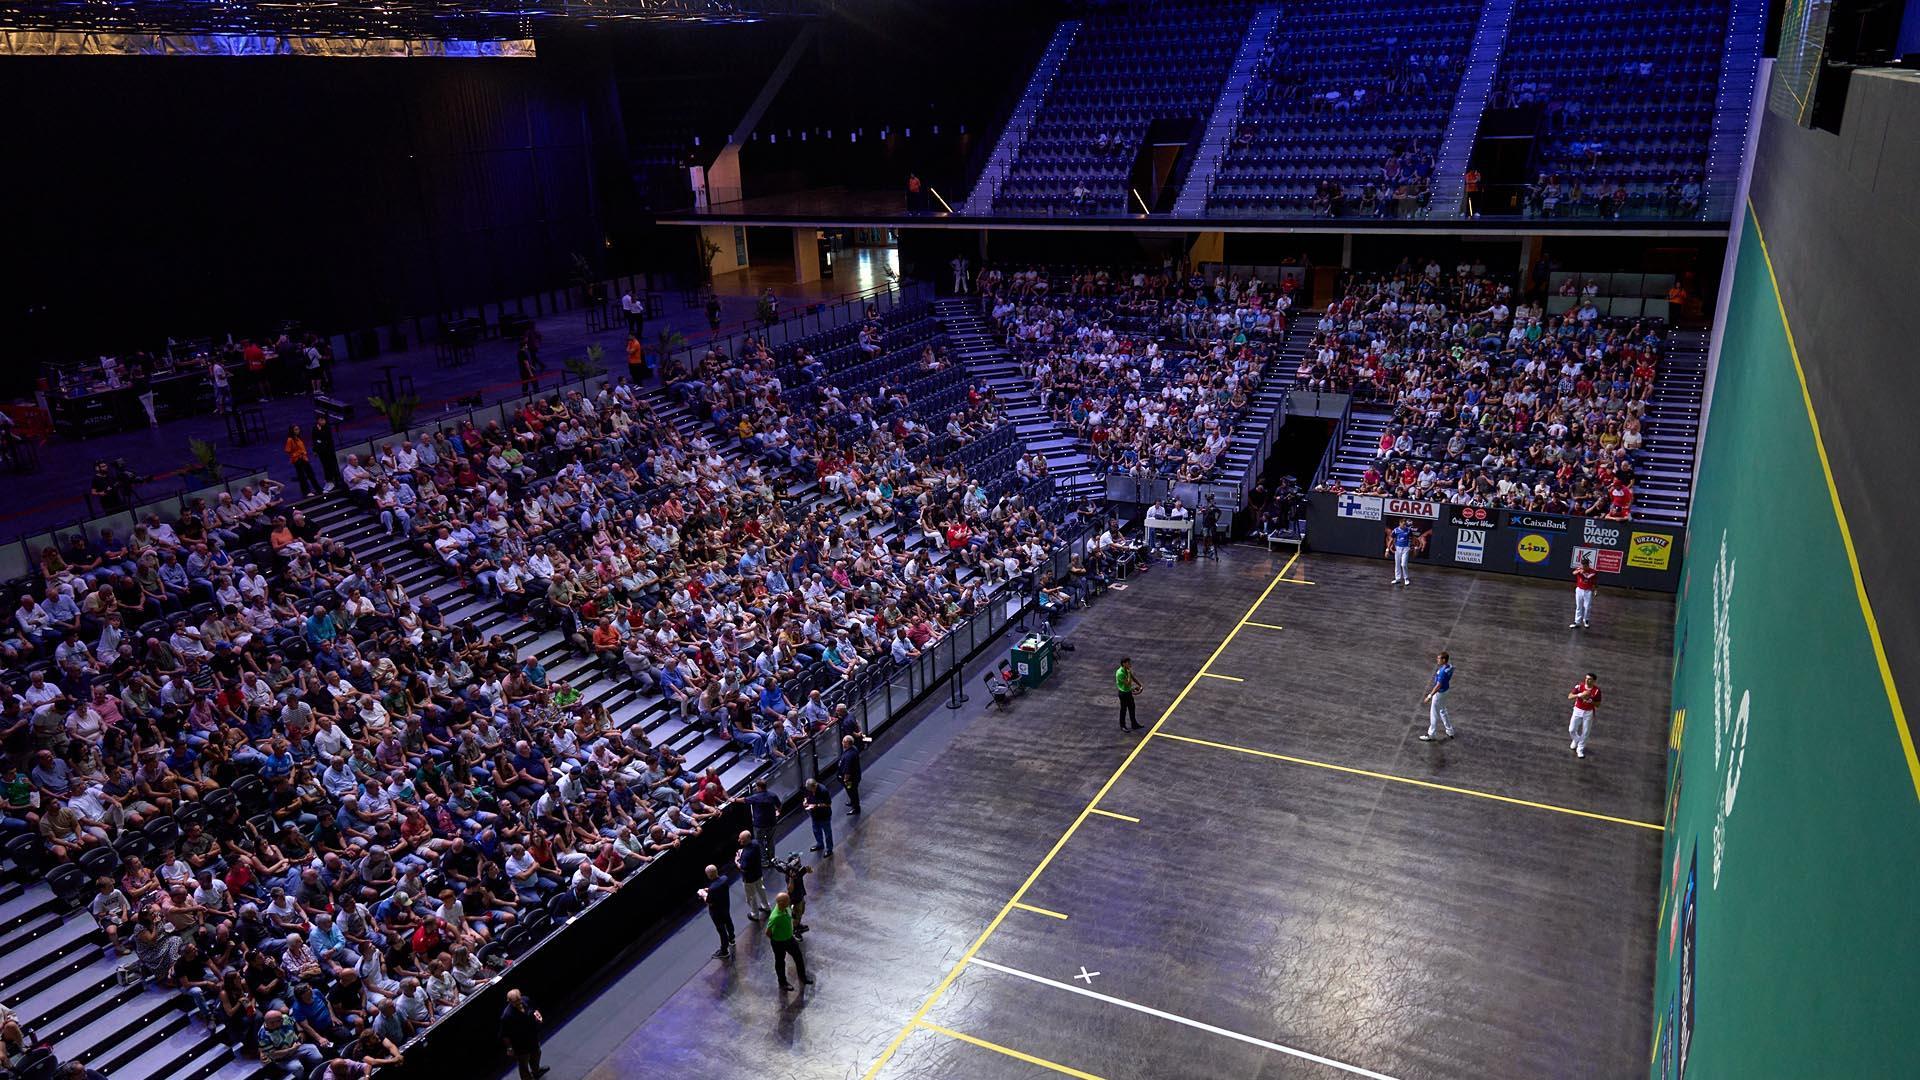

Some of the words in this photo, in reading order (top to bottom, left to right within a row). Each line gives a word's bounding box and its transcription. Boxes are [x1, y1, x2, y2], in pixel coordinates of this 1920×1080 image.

[1389, 500, 1433, 516] GARA
[1464, 519, 1480, 527] Sport
[1480, 520, 1495, 528] Wear
[1522, 517, 1567, 530] CaixaBank
[1585, 519, 1597, 528] EL
[1459, 530, 1484, 545] DN
[1583, 528, 1619, 538] DIARIO
[1583, 536, 1617, 546] VASCO
[1636, 536, 1666, 547] URZANTE
